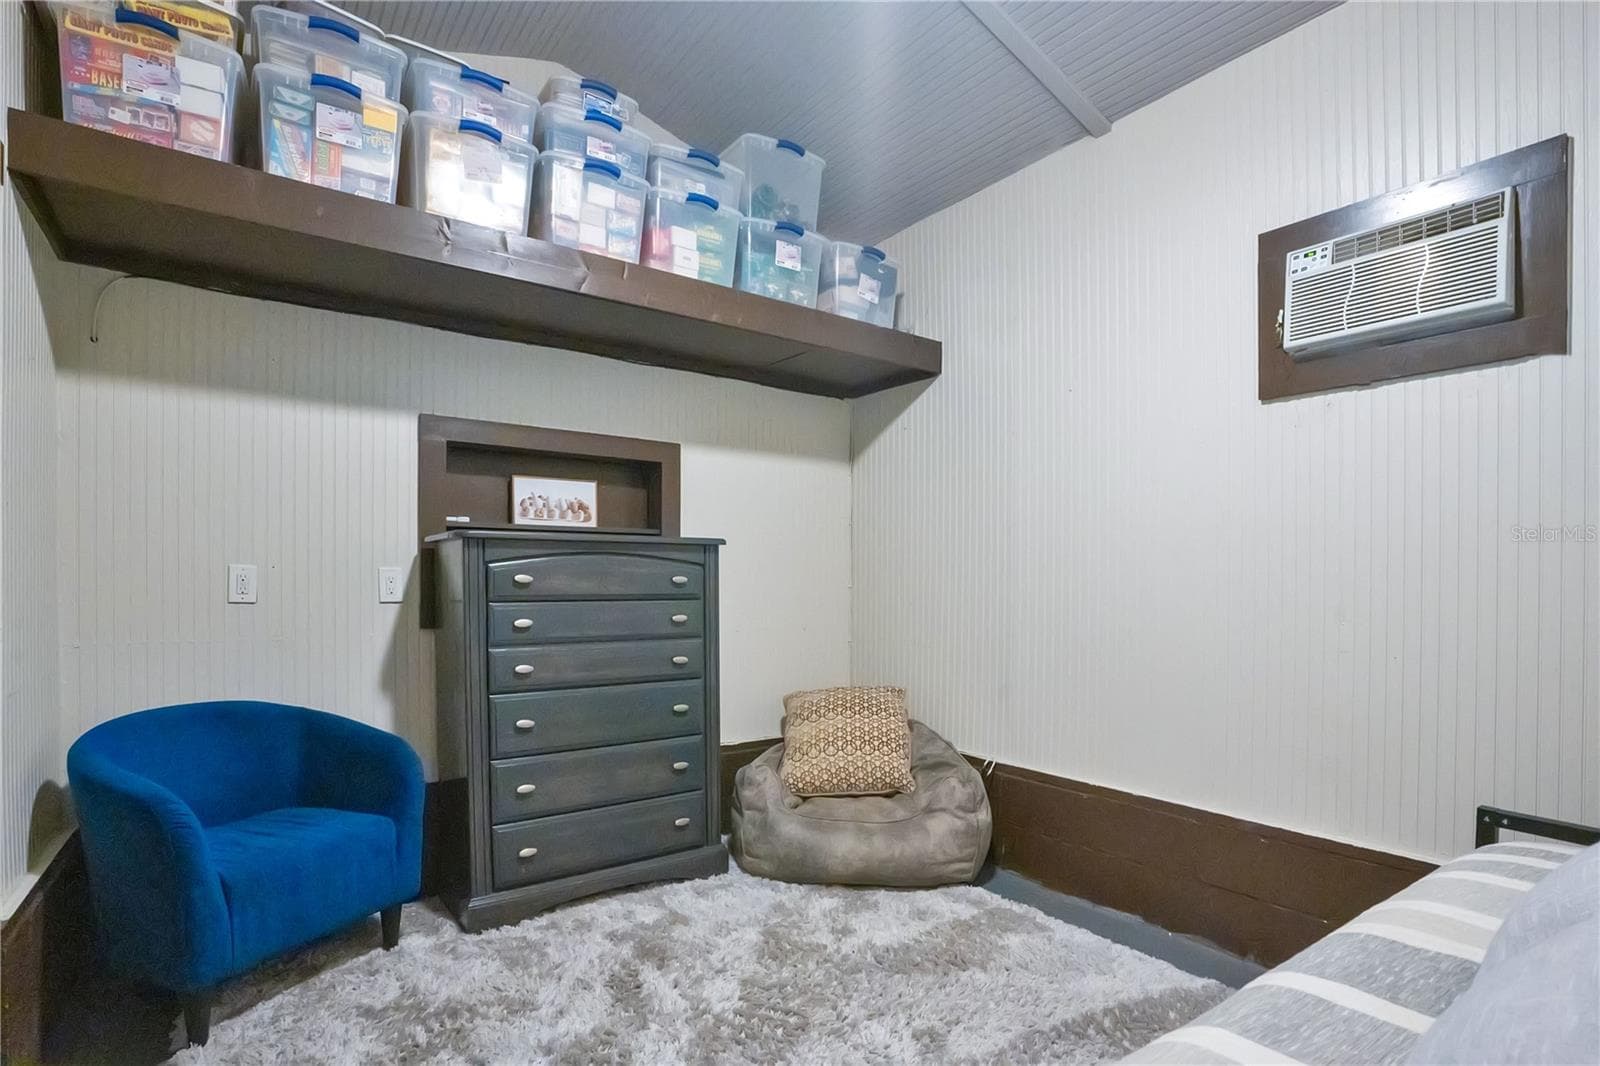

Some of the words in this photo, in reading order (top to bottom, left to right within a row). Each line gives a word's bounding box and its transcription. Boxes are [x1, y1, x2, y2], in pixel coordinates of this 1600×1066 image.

[166, 9, 200, 28] PHOTO
[103, 25, 139, 44] PHOTO
[91, 69, 123, 90] BASE
